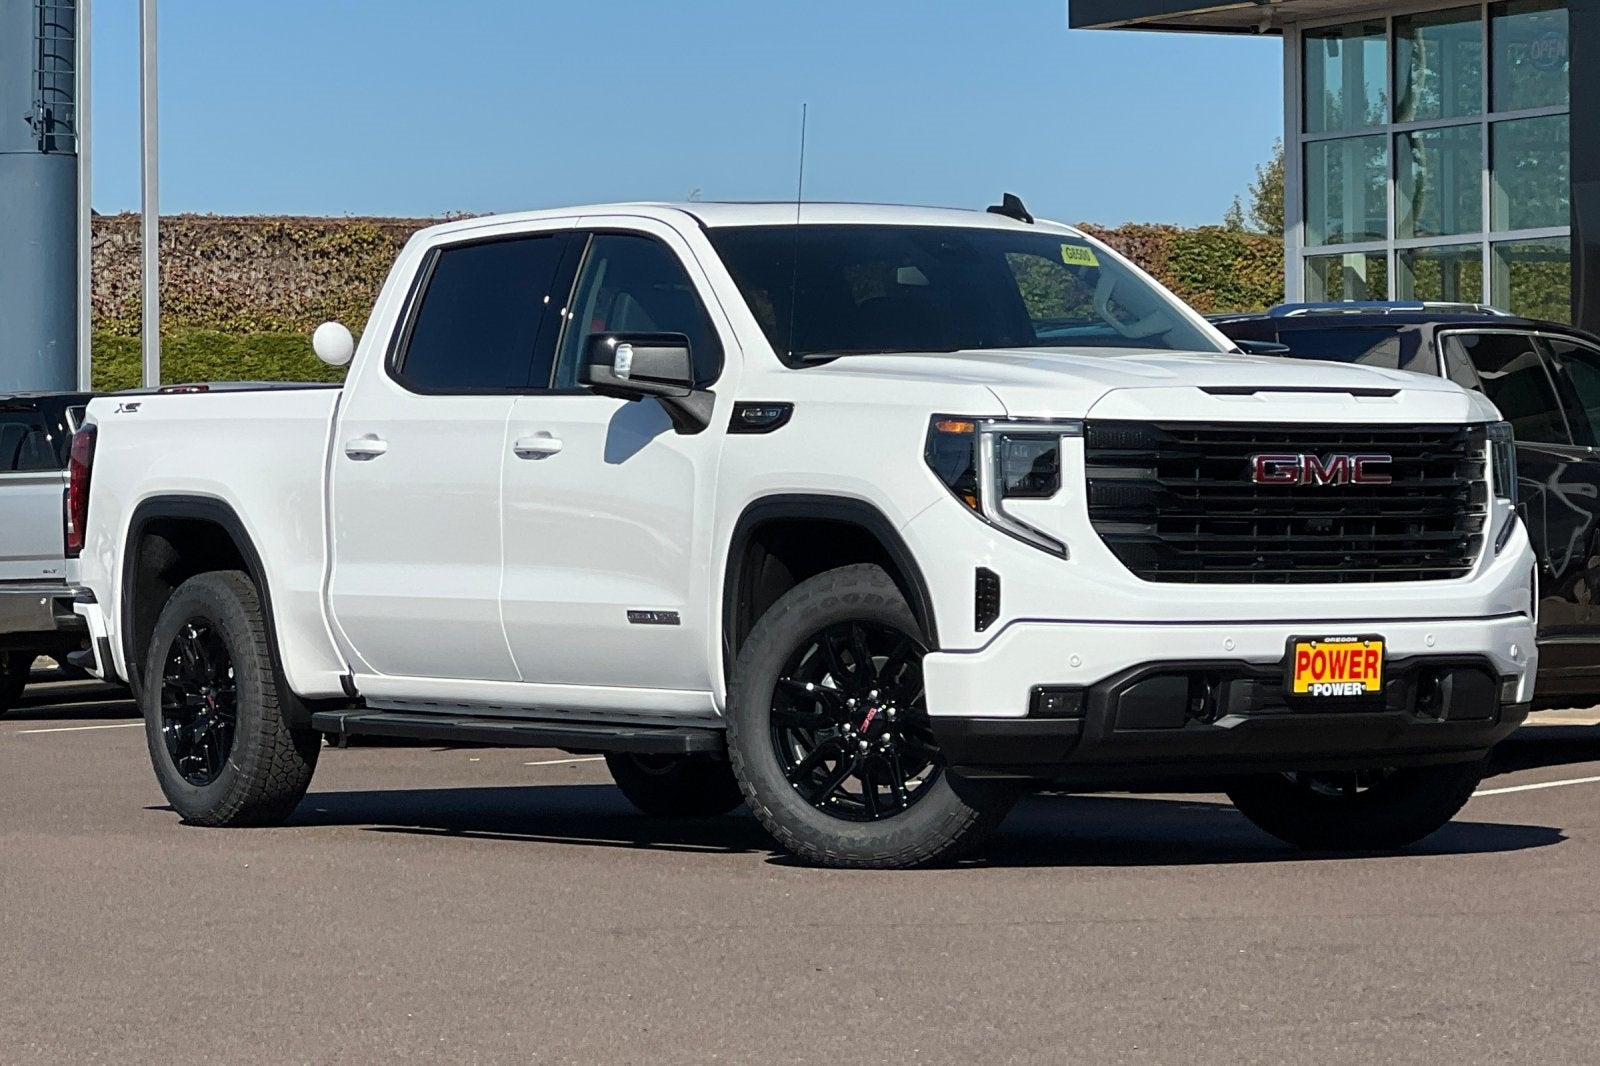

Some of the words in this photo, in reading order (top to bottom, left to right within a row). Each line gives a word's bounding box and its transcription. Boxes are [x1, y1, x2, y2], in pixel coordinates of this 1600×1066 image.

[1252, 454, 1393, 485] GMC
[1296, 650, 1379, 680] POWER
[1313, 682, 1362, 696] POWER
